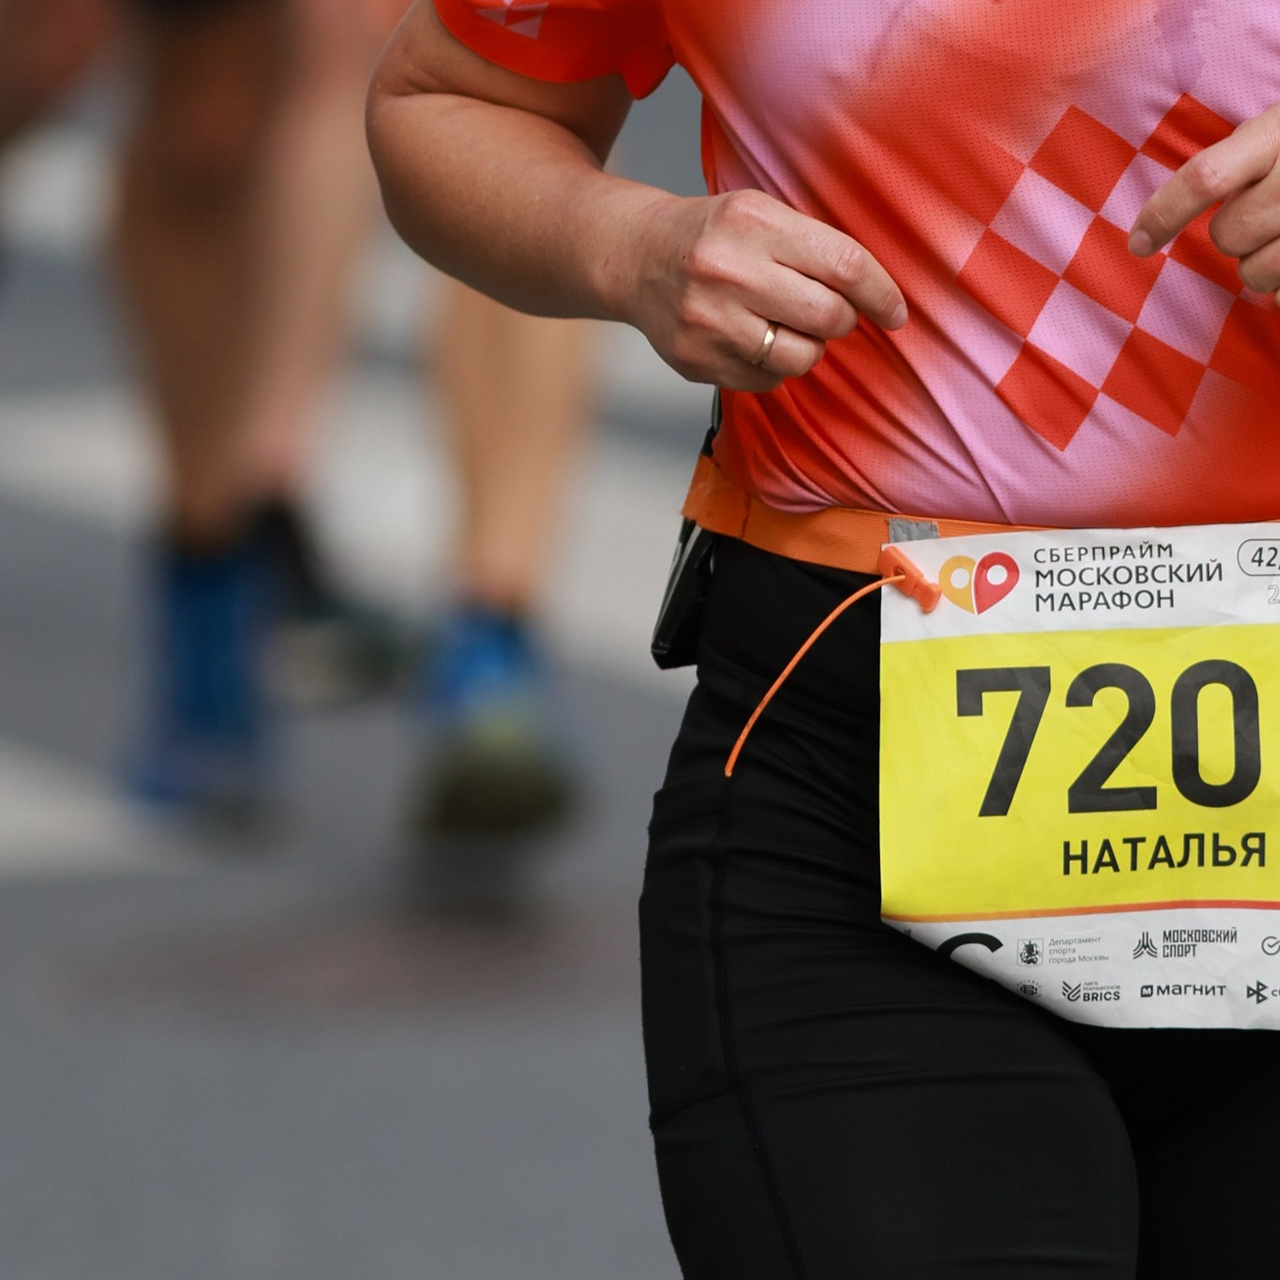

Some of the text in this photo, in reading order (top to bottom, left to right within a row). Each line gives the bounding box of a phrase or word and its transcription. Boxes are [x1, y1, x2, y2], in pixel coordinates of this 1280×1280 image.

[1034, 541, 1173, 564] СБЕРПРАЙМ
[1035, 558, 1223, 588] МОСКОВСКИЙ
[1035, 589, 1174, 612] МАРАФОН
[1063, 832, 1266, 875] НАТАЛЬЯ
[1048, 937, 1101, 946] Департамент
[1163, 926, 1237, 944] МОСКОВСКИЙ
[1163, 944, 1197, 958] СПОРТ
[1083, 991, 1120, 1002] BRICS
[1156, 984, 1226, 996] магнит
